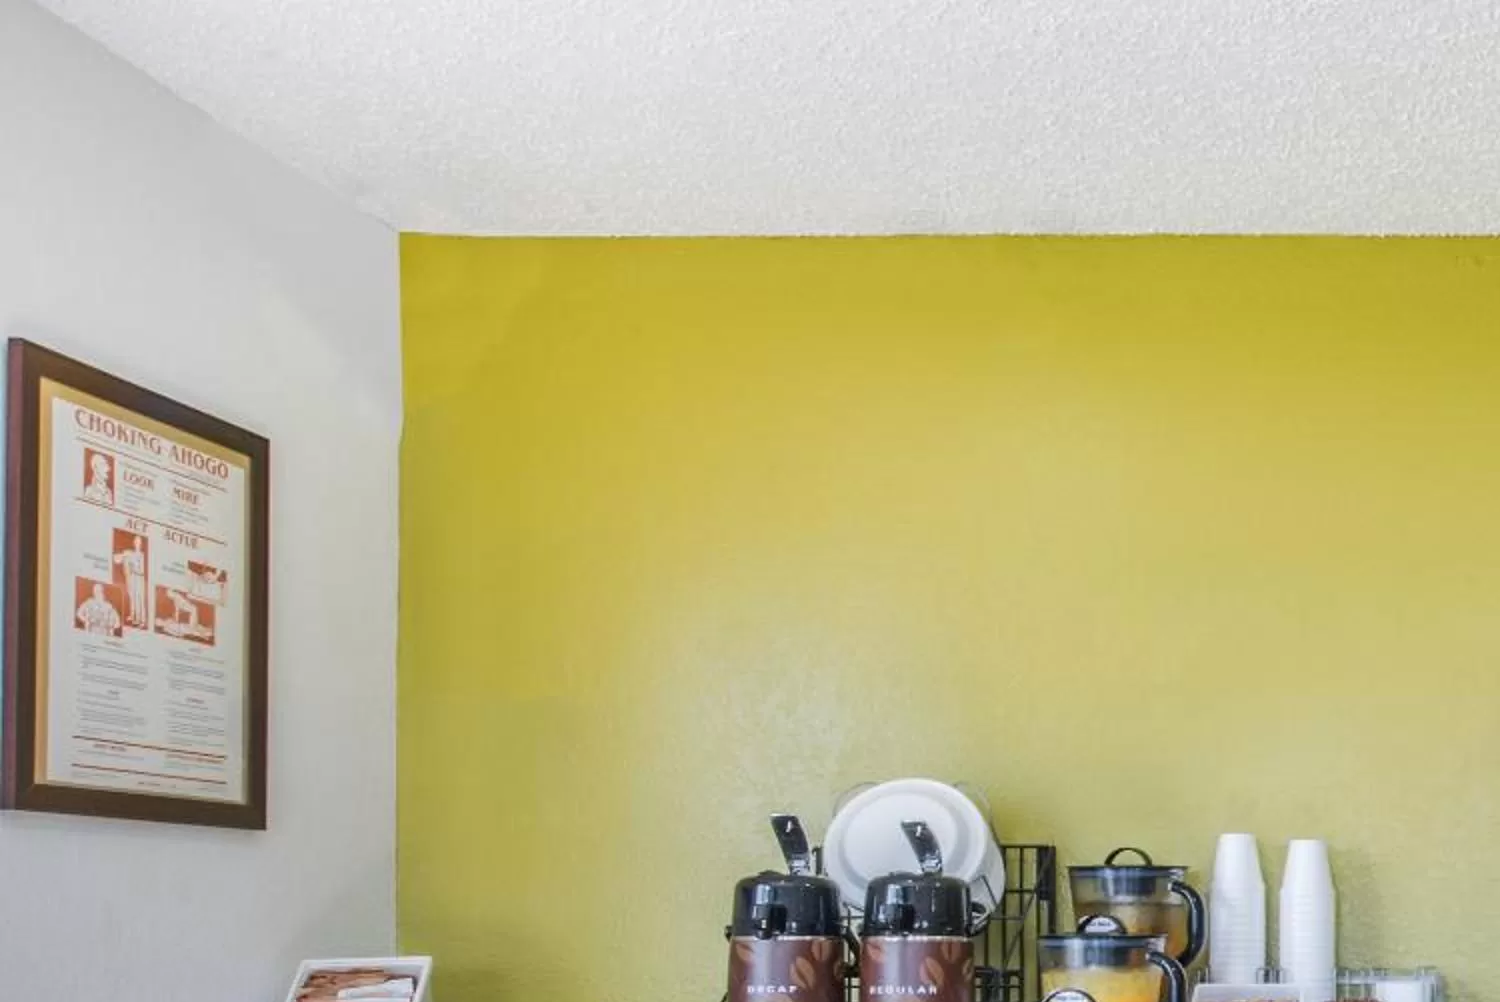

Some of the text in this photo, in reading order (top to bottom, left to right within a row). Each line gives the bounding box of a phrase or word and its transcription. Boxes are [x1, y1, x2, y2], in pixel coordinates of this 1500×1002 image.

[74, 408, 230, 479] CHOKING AHOGO
[125, 518, 149, 533] ACT
[747, 984, 800, 994] DECAF
[869, 984, 938, 995] REGULAR
